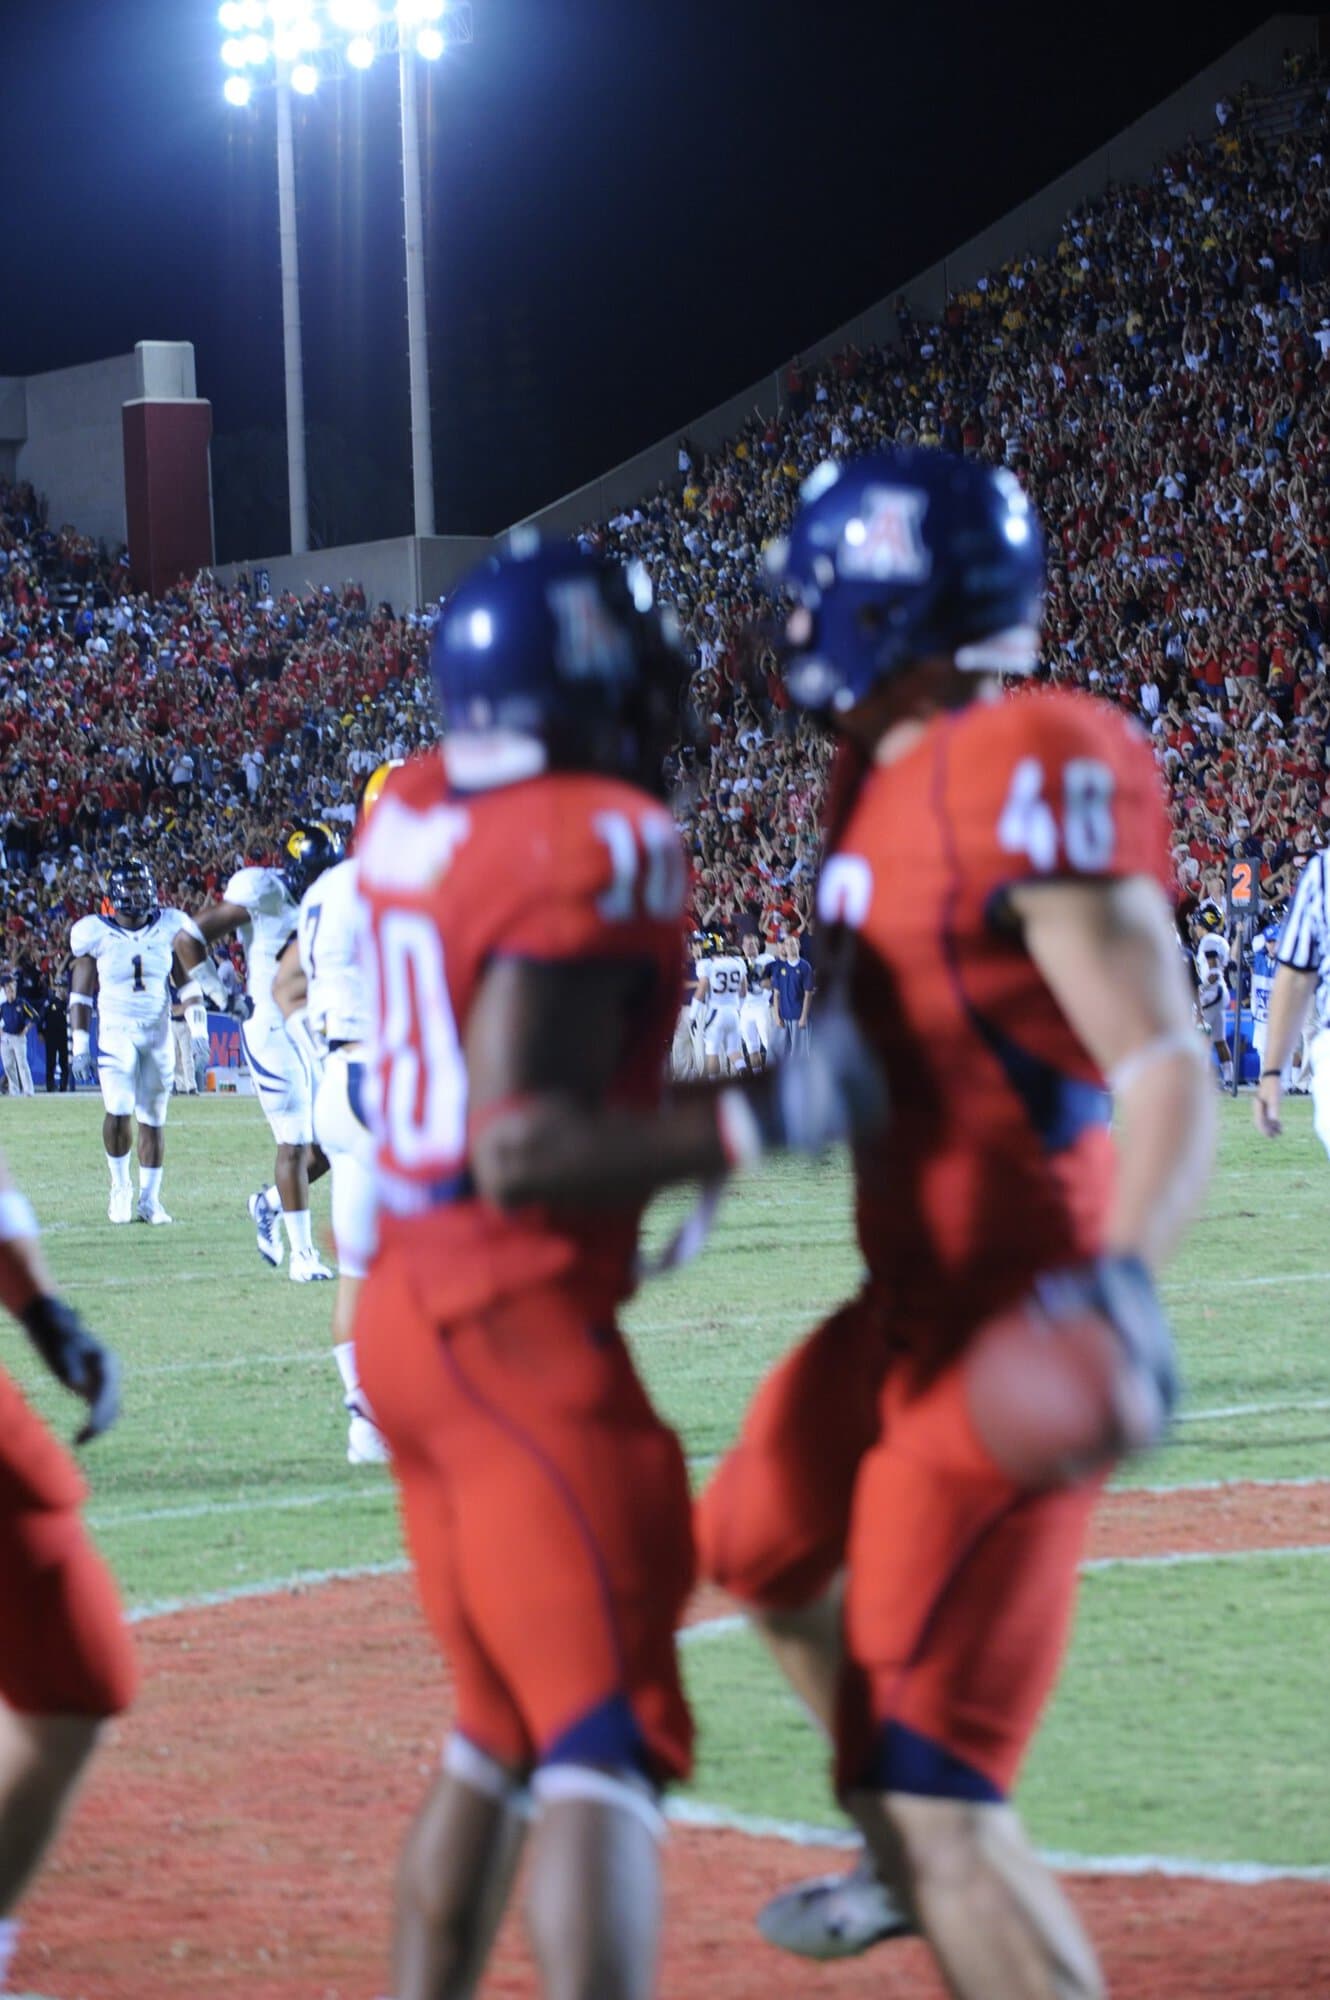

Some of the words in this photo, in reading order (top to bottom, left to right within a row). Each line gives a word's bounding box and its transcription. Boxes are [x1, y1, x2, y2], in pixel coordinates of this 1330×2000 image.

[1231, 862, 1252, 899] 2
[131, 954, 146, 992] 1
[713, 971, 741, 994] 39
